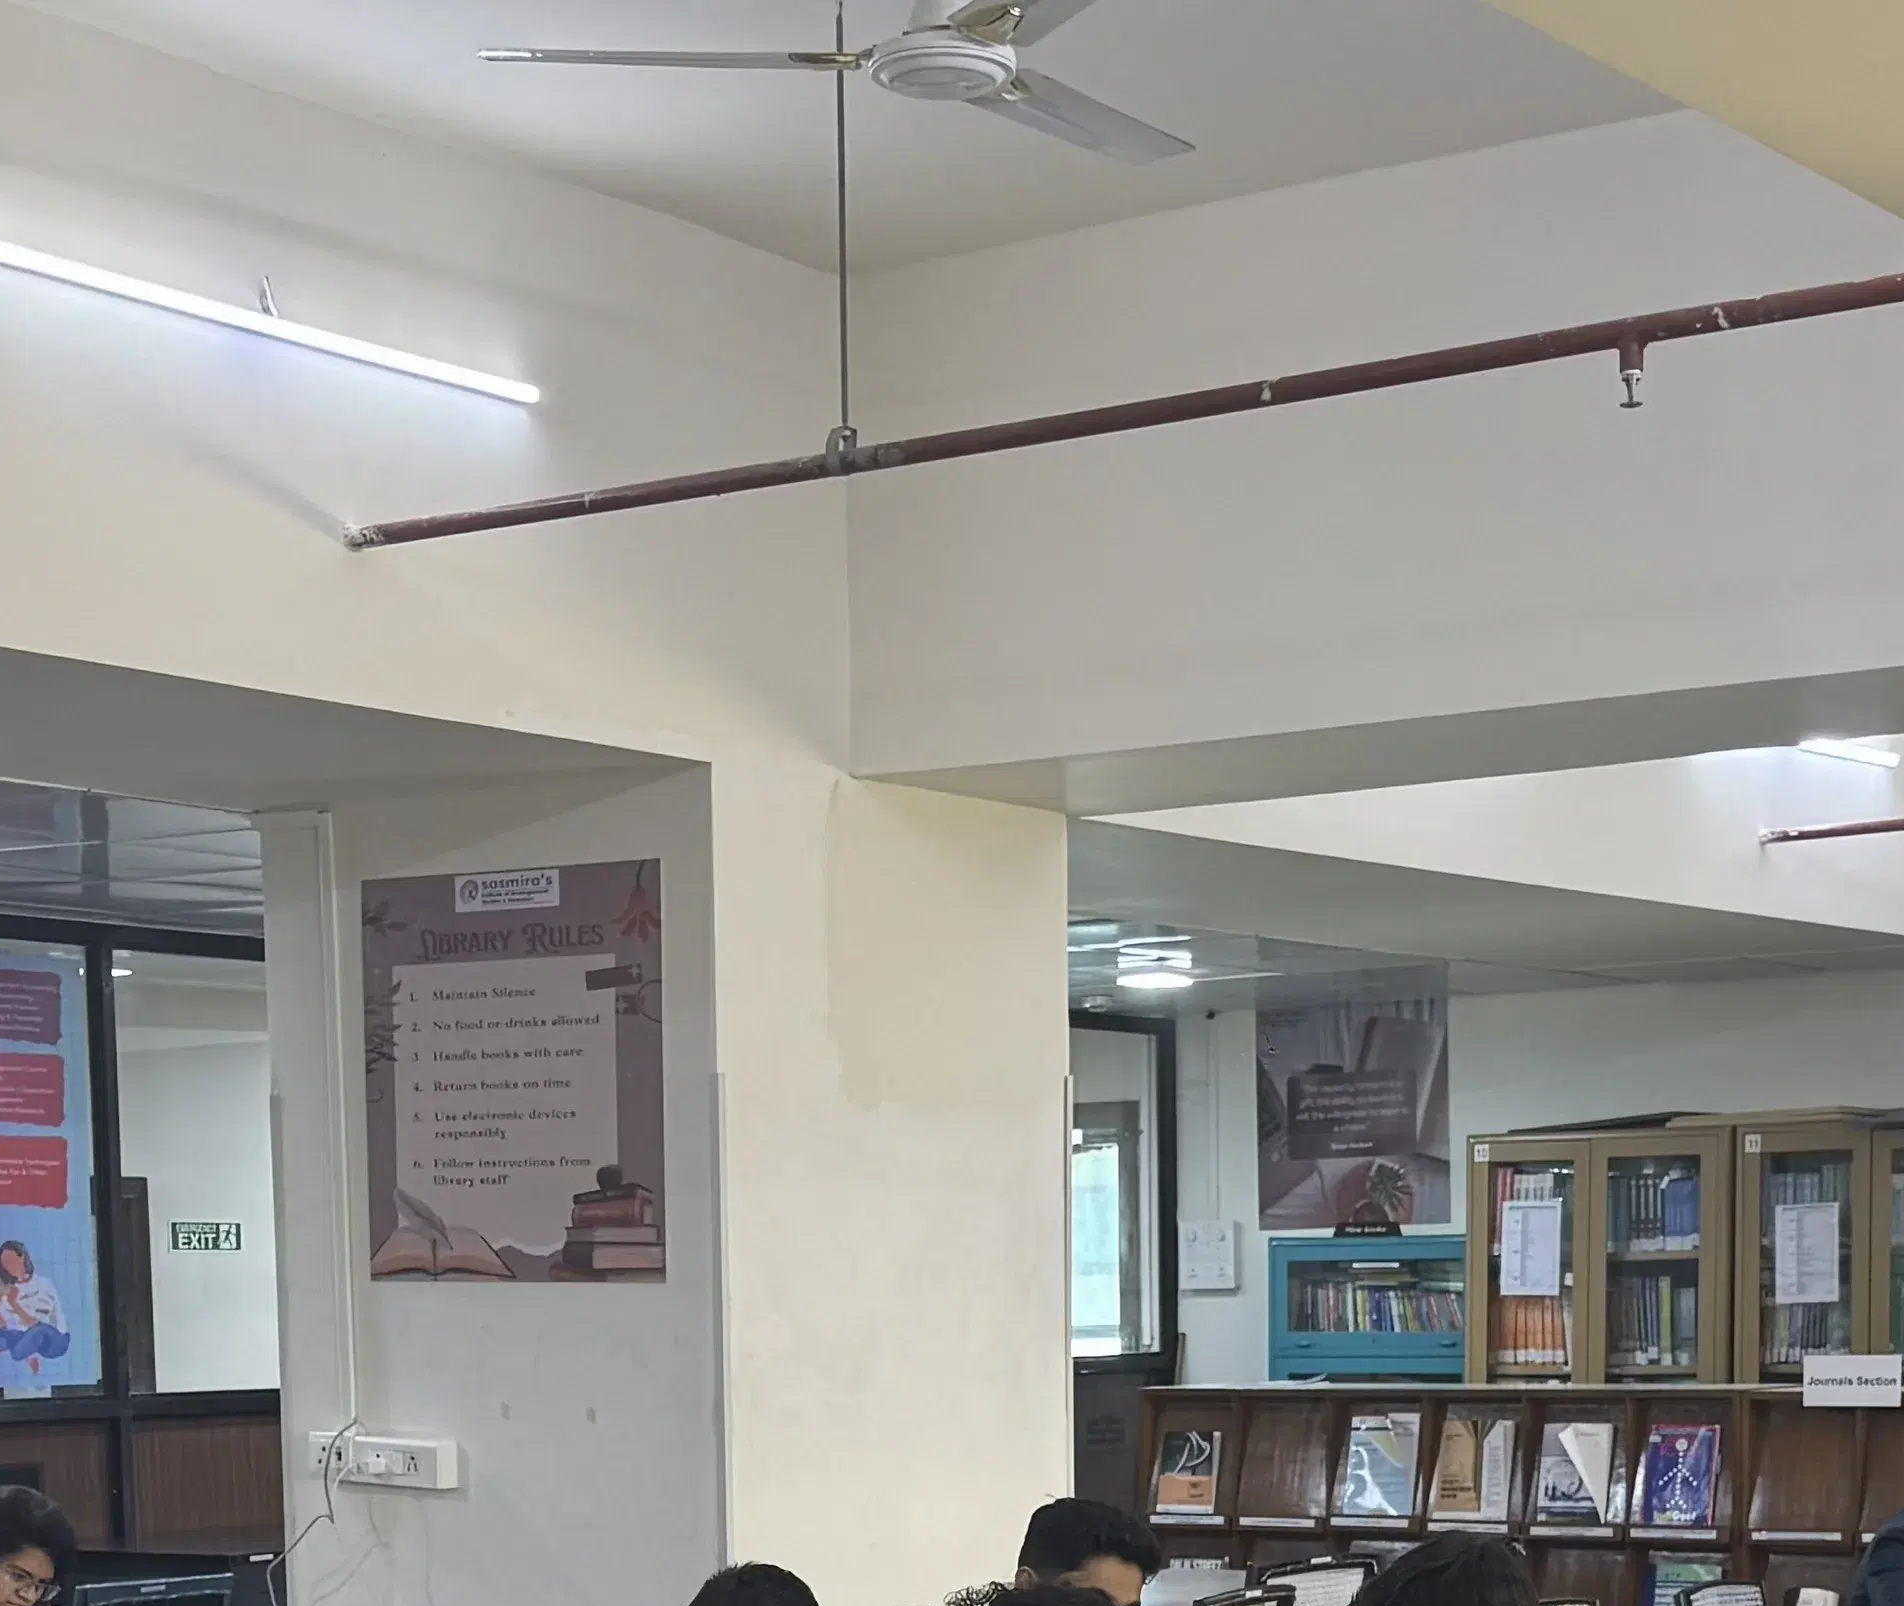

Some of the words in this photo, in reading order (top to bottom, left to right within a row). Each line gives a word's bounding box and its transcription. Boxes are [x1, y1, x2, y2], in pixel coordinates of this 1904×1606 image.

[432, 991, 487, 1001] Maintain
[492, 987, 536, 998] Silence
[433, 1021, 451, 1031] No
[455, 1019, 483, 1030] food
[487, 1021, 501, 1029] or
[505, 1016, 546, 1028] drinks
[551, 1014, 600, 1026] allowed
[433, 1050, 477, 1062] Handle
[481, 1049, 520, 1060] books
[524, 1047, 551, 1058] with
[556, 1049, 583, 1057] care
[434, 1081, 477, 1092] Return
[481, 1079, 519, 1090] books
[523, 1081, 539, 1089] on
[544, 1078, 571, 1088] time
[435, 1111, 457, 1121] Use
[462, 1109, 524, 1121] electronic
[528, 1108, 576, 1120] devices
[434, 1128, 506, 1140] responsibly
[434, 1158, 474, 1169] Follow
[479, 1157, 556, 1168] instructions
[559, 1156, 591, 1166] from
[433, 1175, 474, 1188] library
[479, 1174, 510, 1185] staff
[178, 1233, 216, 1249] EXIT
[1808, 1376, 1853, 1386] Journals
[1856, 1376, 1896, 1386] Section
